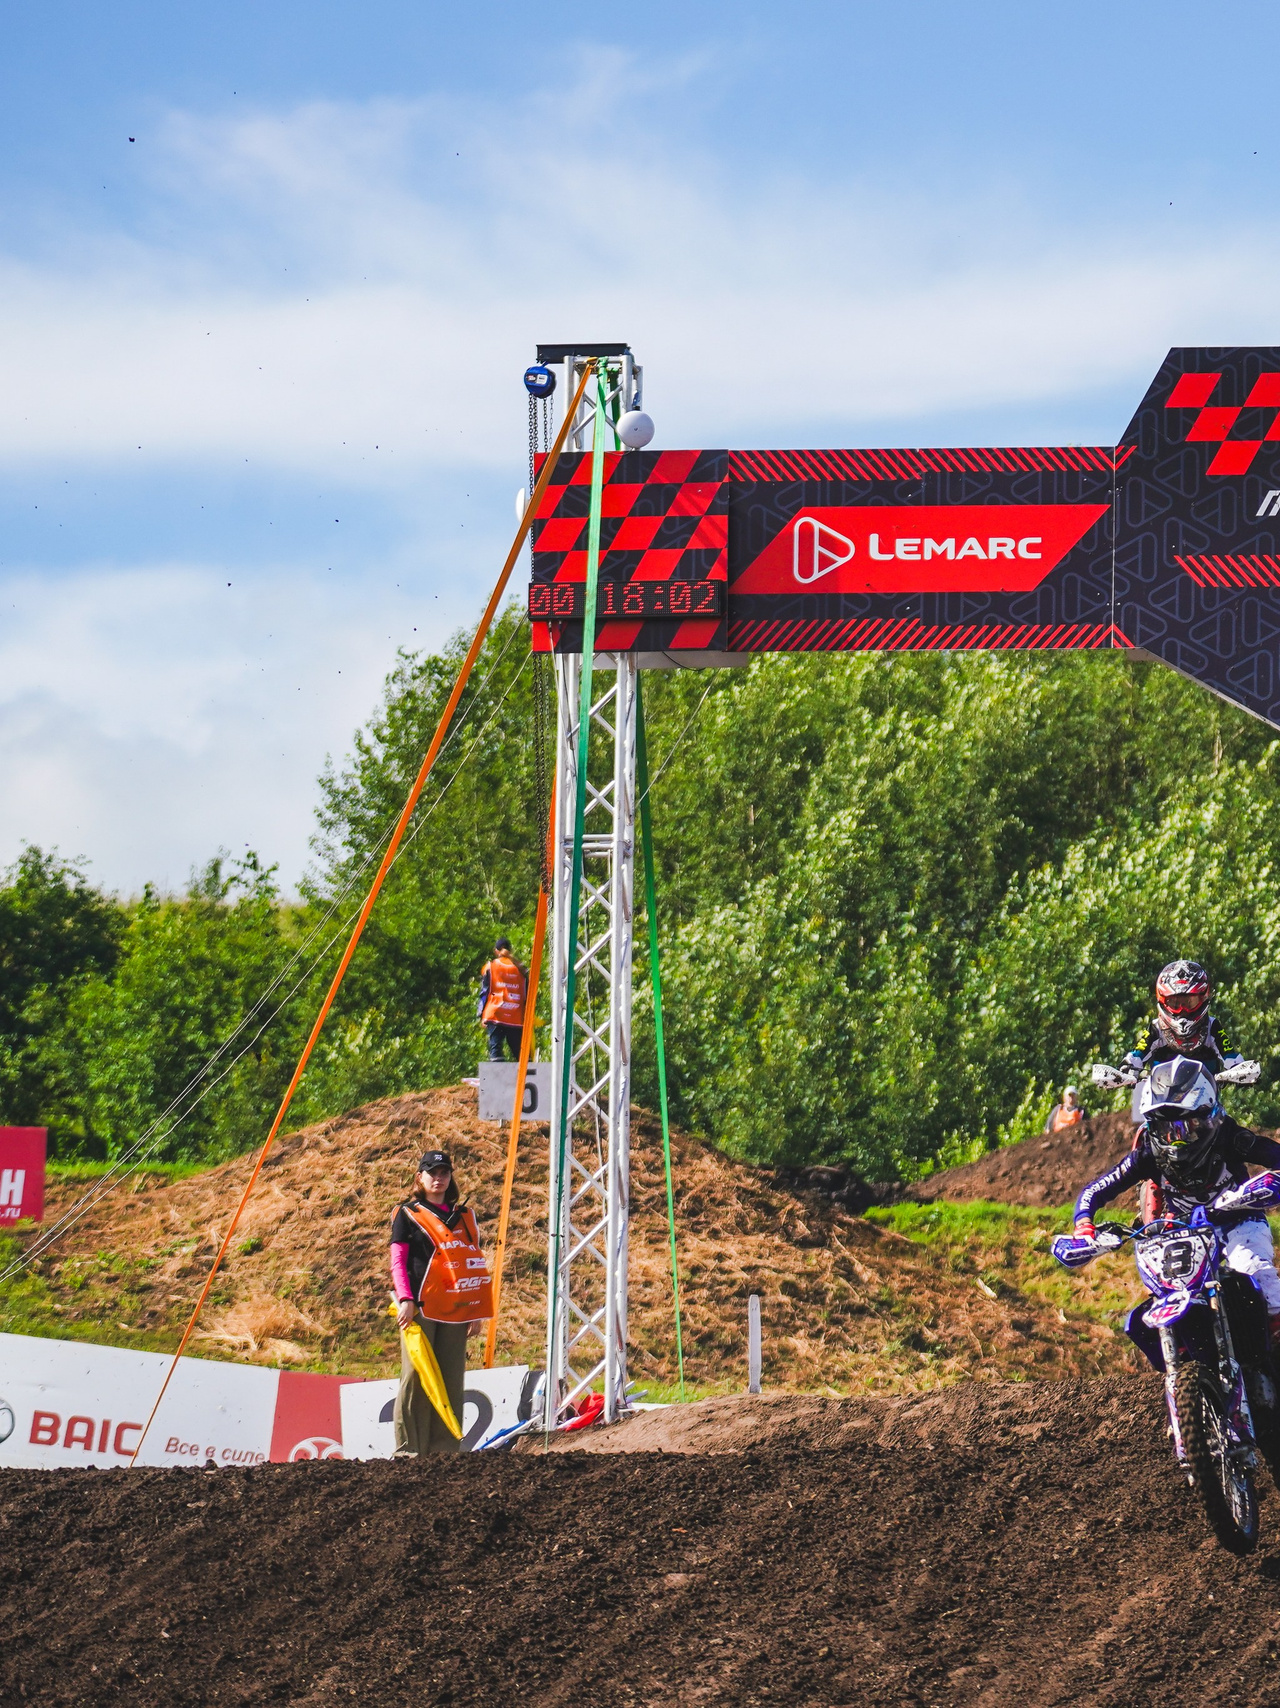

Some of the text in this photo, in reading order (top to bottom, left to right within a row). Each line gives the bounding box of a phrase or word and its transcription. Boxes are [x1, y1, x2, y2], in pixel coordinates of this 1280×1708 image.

[868, 532, 1042, 562] LEMARC
[529, 581, 716, 616] 00 18:02
[29, 1410, 144, 1457] BAIC
[164, 1436, 199, 1457] Все
[221, 1447, 266, 1465] силе
